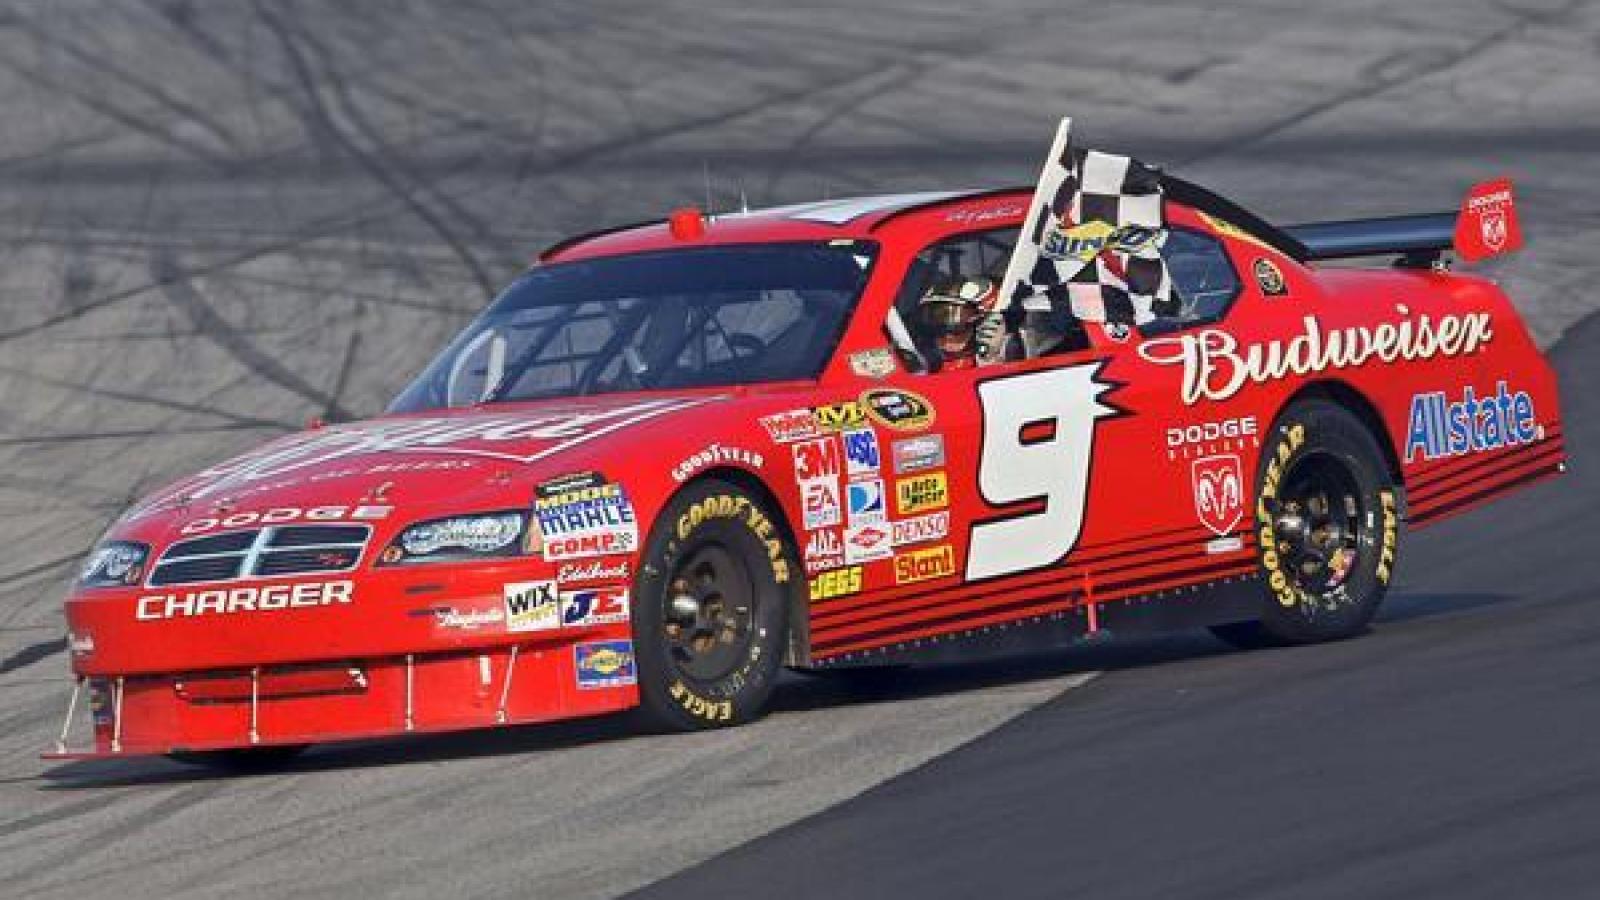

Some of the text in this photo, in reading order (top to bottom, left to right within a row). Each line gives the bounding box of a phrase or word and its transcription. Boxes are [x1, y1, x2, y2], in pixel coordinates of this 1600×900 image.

[1136, 303, 1493, 404] Budweiser
[1167, 417, 1258, 446] DODGE
[1404, 381, 1540, 463] Allstate
[671, 442, 764, 483] GOODYEAR
[796, 443, 838, 480] 3M
[845, 430, 879, 468] USG
[966, 360, 1125, 582] 9
[807, 484, 838, 511] EA
[1257, 424, 1305, 607] GOODYEAR
[181, 505, 396, 534] DODGE
[539, 507, 634, 535] MAHLE
[893, 514, 948, 541] DENSO
[1376, 491, 1397, 584] EAGLE
[547, 532, 615, 556] COMP
[676, 494, 790, 584] GOODYEAR
[897, 548, 951, 580] Stant
[135, 581, 354, 620] CHARGER
[508, 583, 554, 615] WIX
[564, 590, 623, 624] JE
[669, 679, 732, 720] EAGLE
